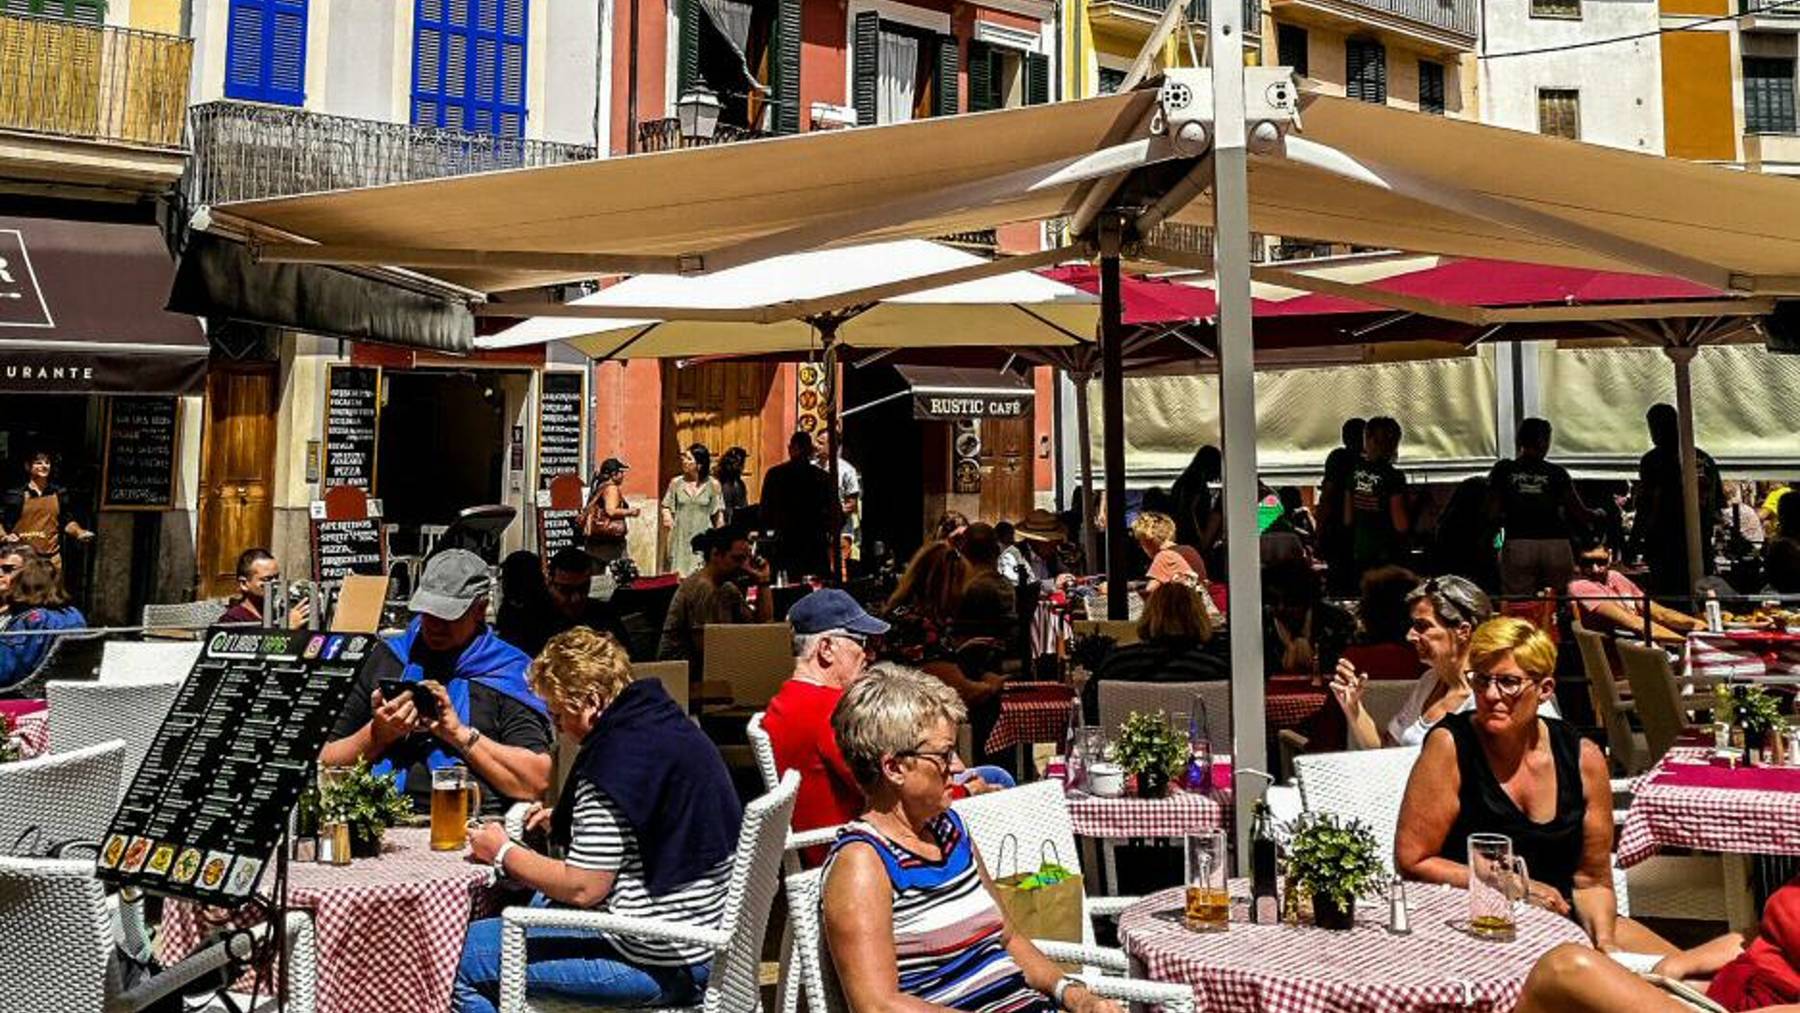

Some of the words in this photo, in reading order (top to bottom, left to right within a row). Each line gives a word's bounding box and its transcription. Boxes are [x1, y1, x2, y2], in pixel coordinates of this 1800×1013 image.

[7, 366, 93, 379] URANTE
[930, 399, 984, 414] RUSTIC
[989, 400, 1020, 415] CAFÉ
[334, 467, 361, 477] PIZZA
